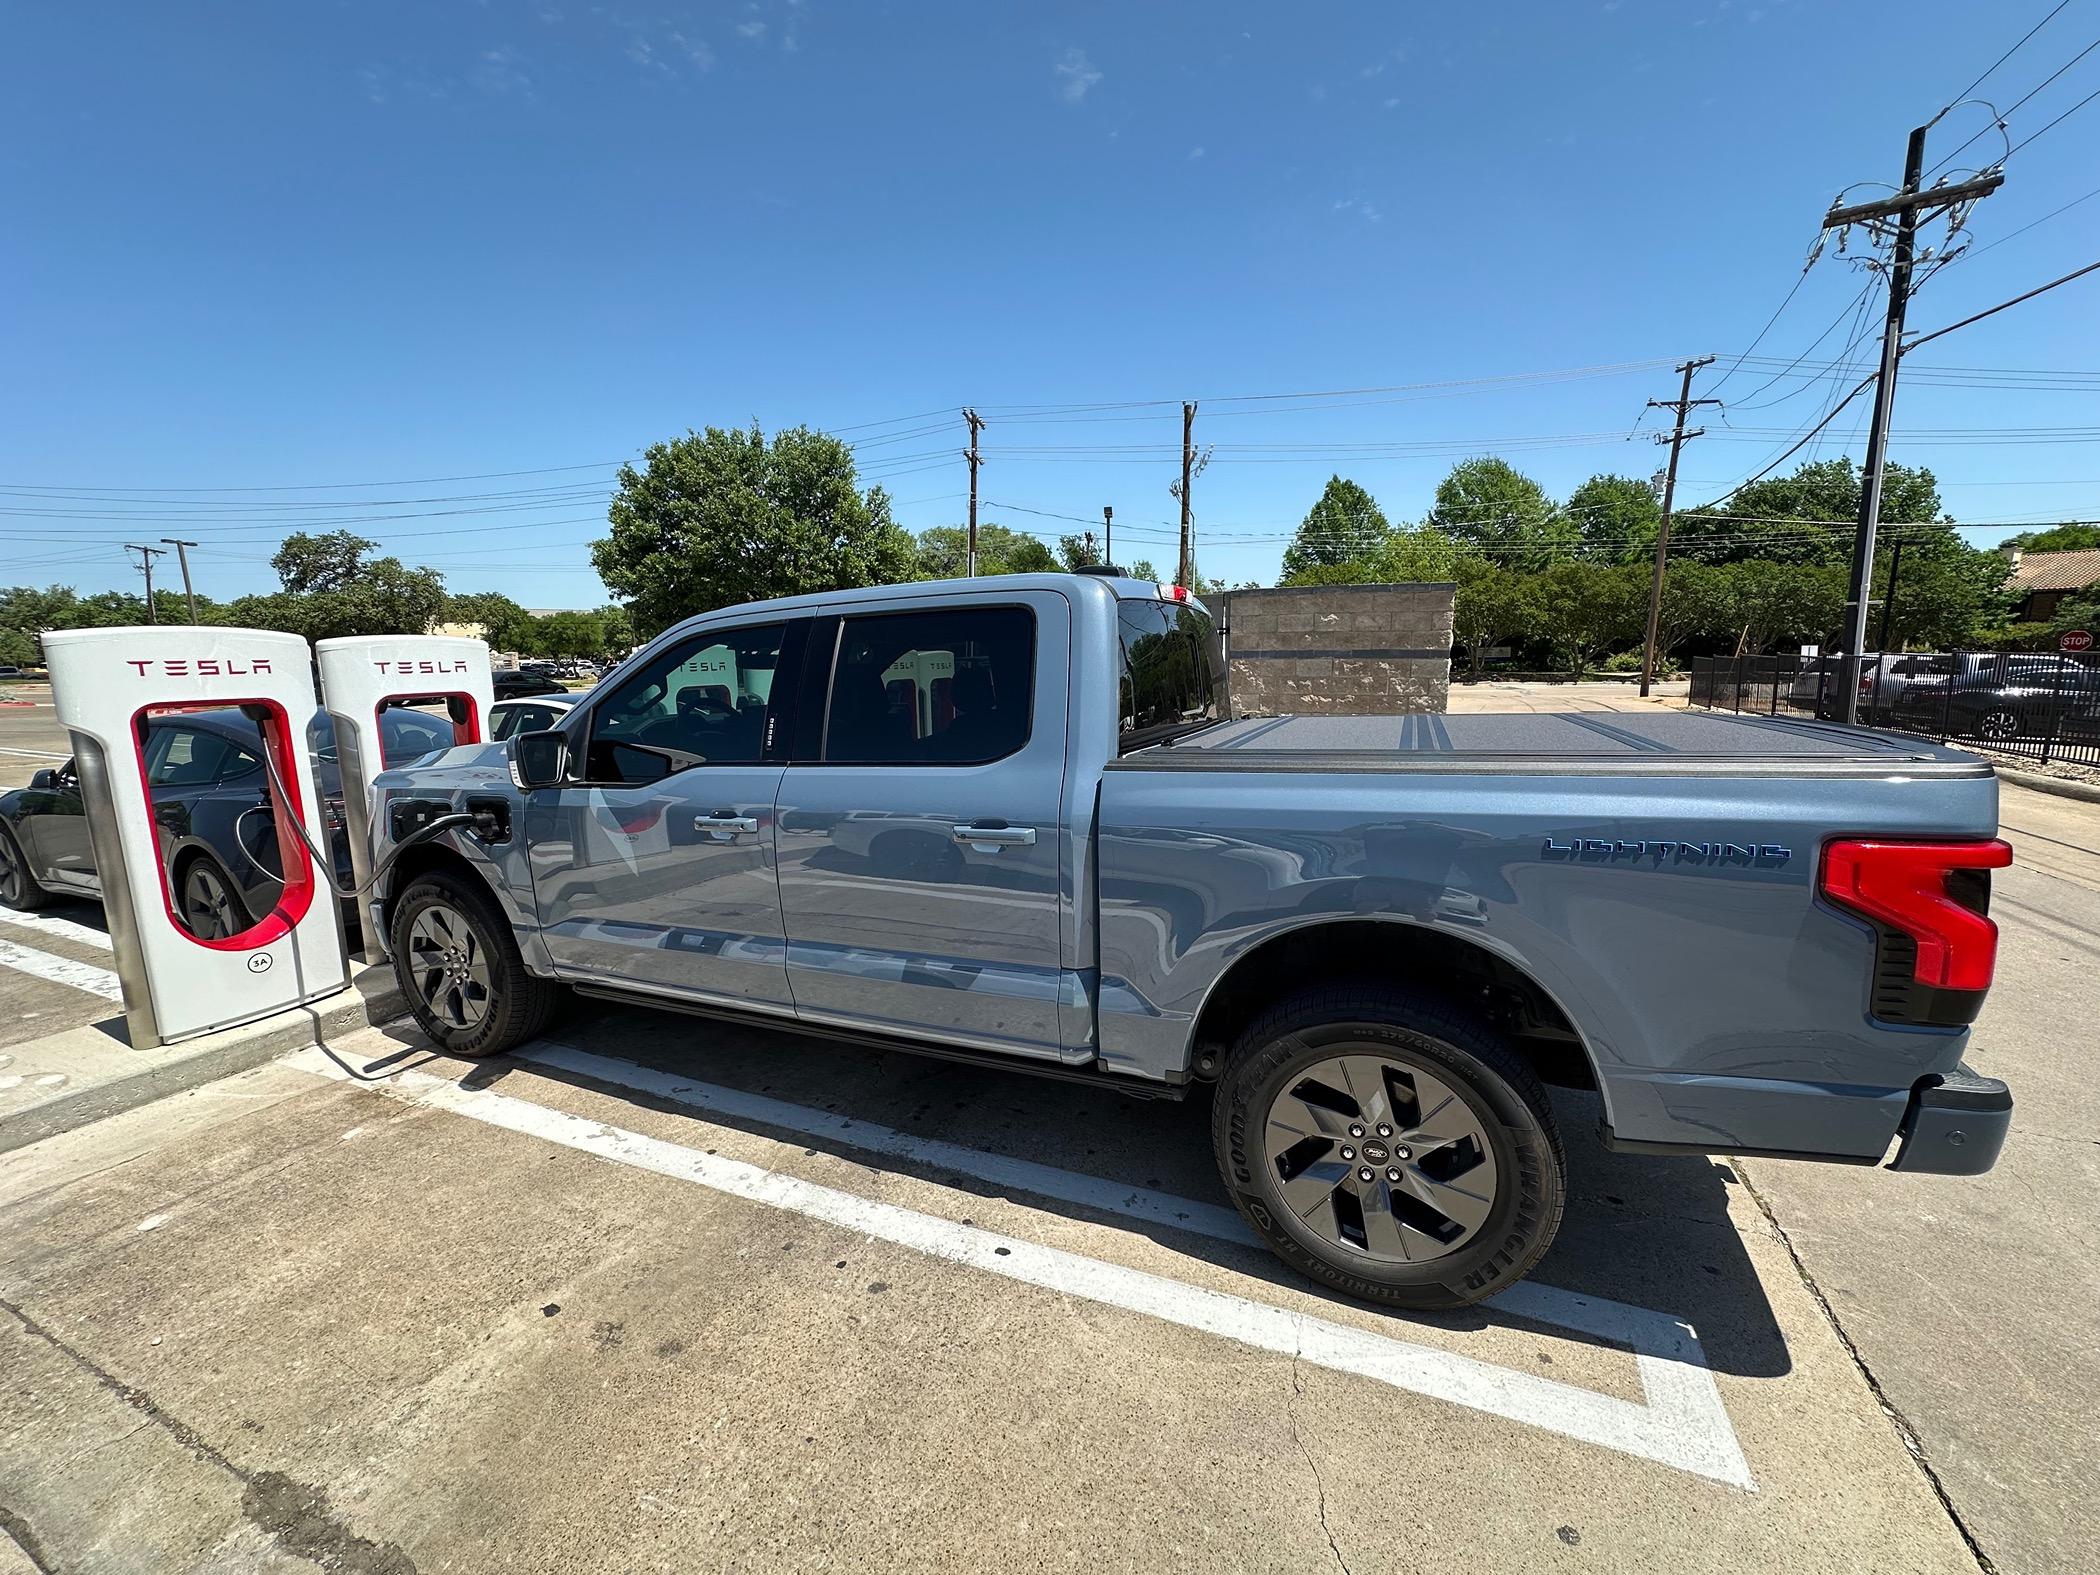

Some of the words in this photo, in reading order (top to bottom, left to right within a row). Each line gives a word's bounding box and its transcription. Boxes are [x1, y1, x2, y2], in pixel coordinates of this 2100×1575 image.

[2063, 637, 2090, 645] STOP
[126, 659, 272, 677] TESLA
[373, 661, 467, 675] TESLA
[680, 662, 726, 673] TESLA
[890, 661, 914, 670] ESLA
[1545, 838, 1792, 859] LIGHTNING
[253, 958, 268, 968] 3A
[1275, 1236, 1299, 1253] HT
[1304, 1257, 1401, 1299] TERRITORY
